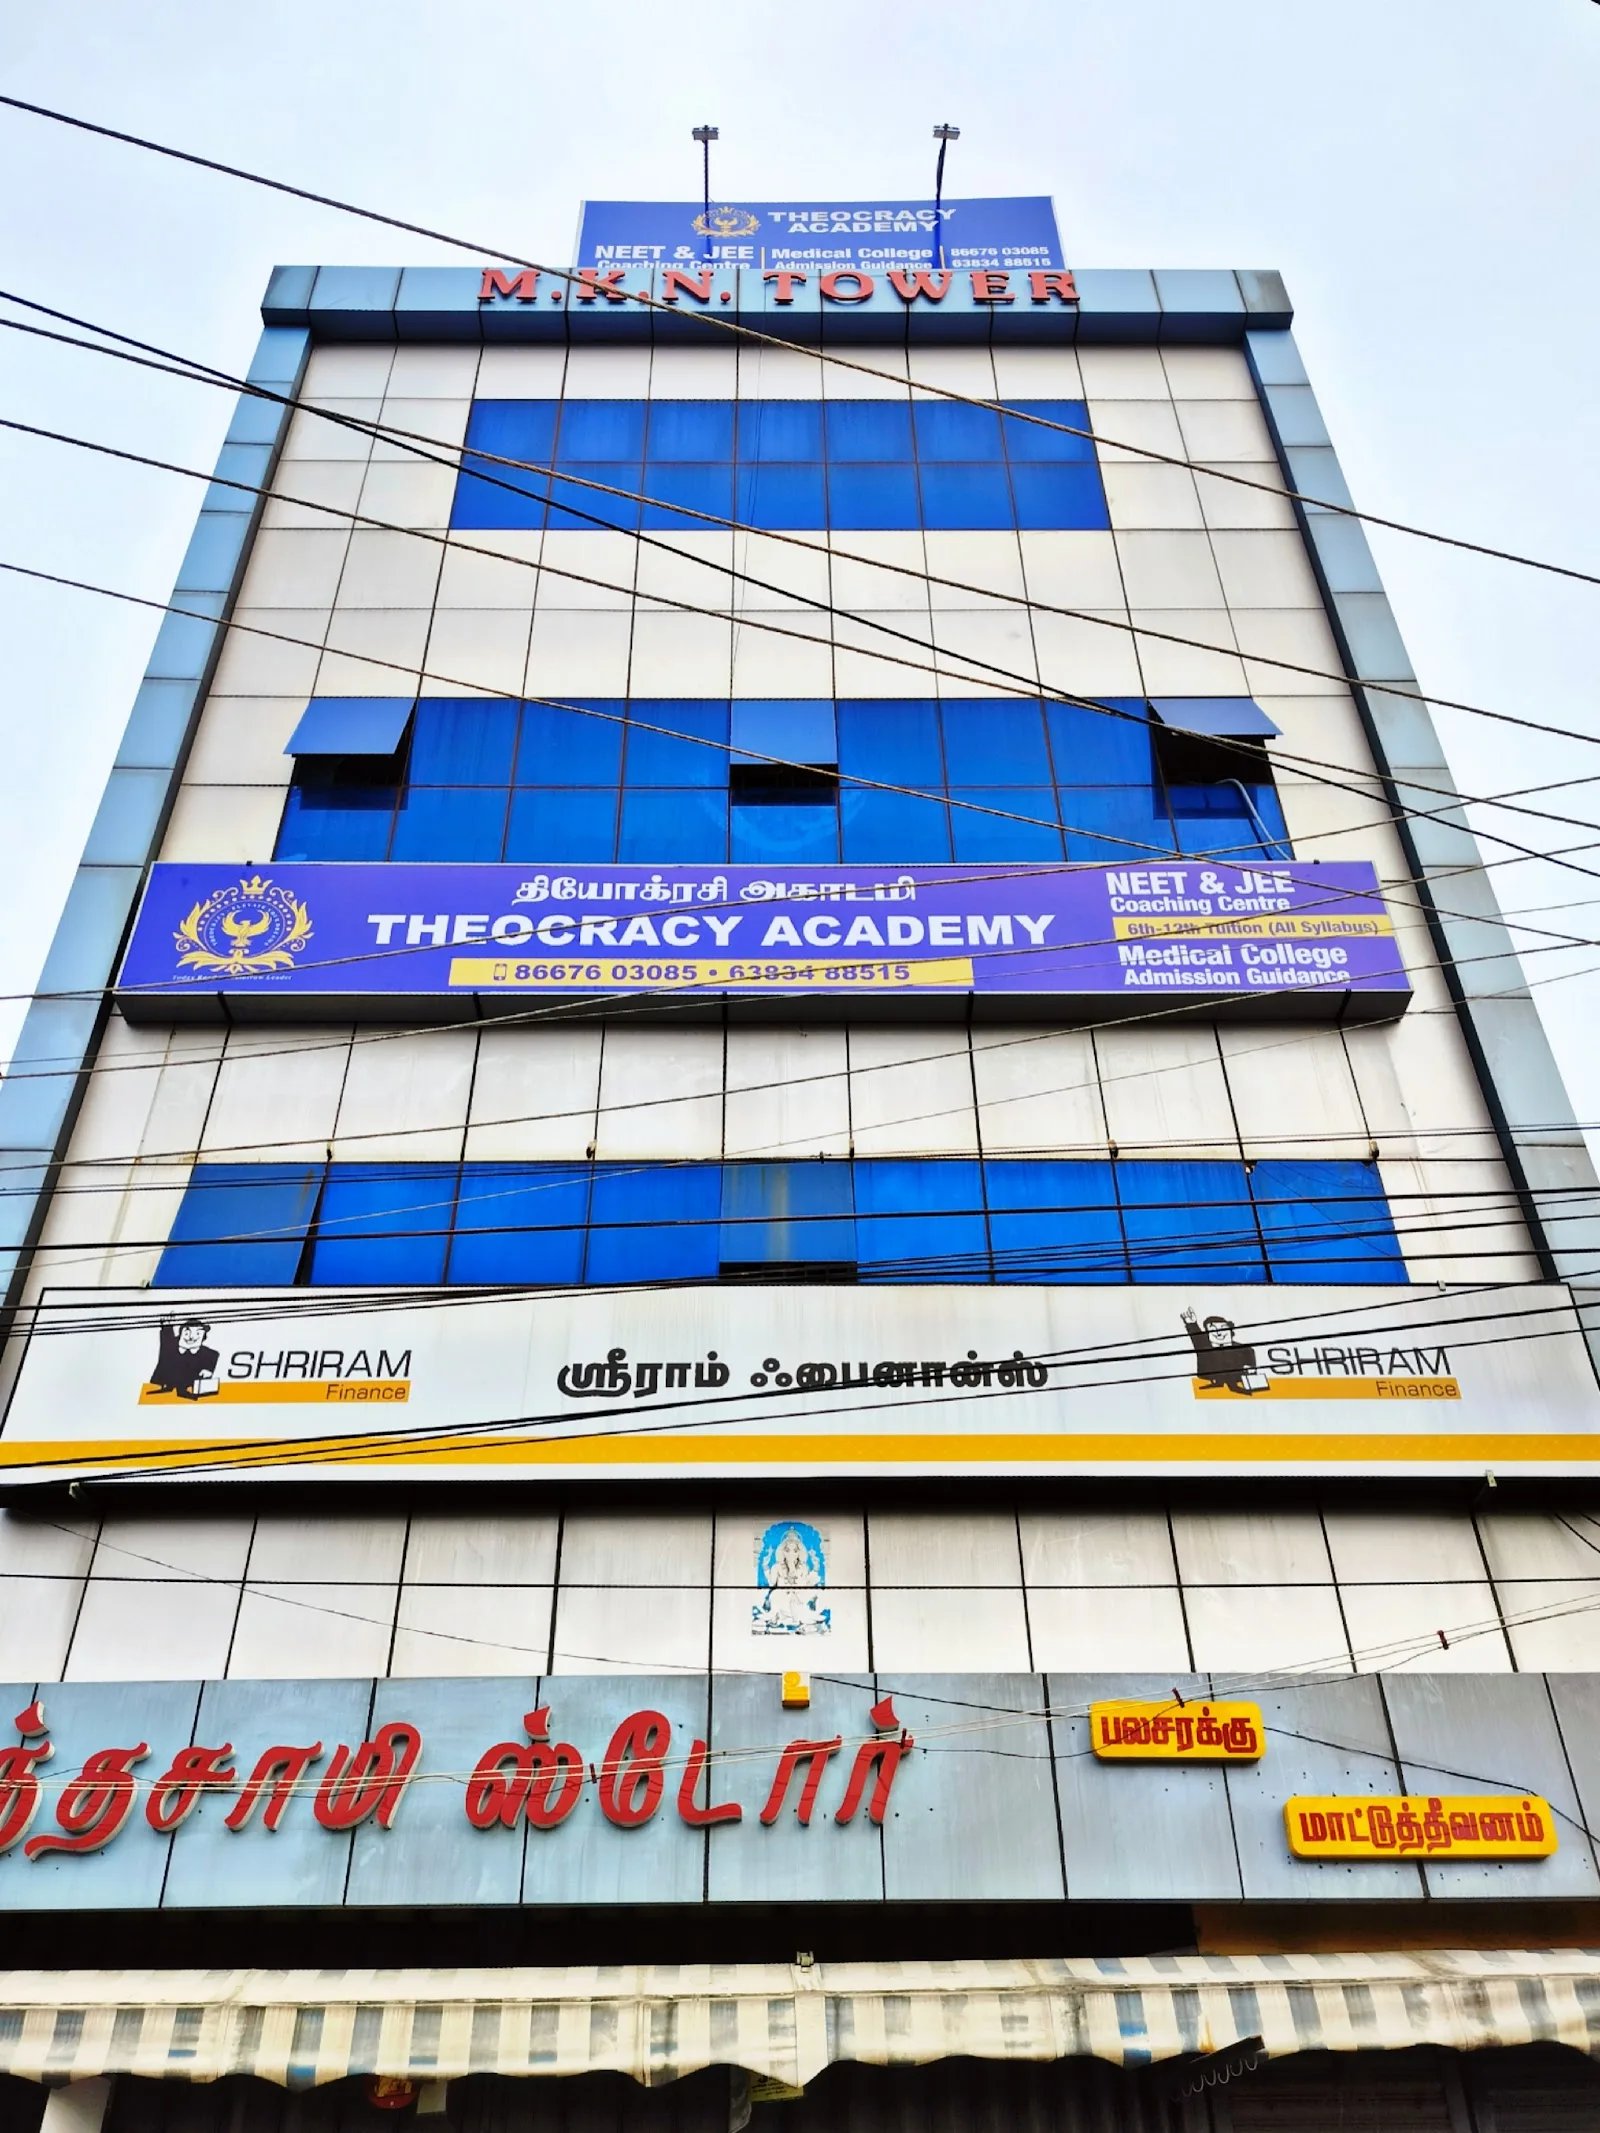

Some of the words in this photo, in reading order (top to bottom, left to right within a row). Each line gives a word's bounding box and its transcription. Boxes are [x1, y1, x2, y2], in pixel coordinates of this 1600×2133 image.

[768, 209, 956, 222] THEOCRACY
[787, 220, 939, 233] ACADEMY
[595, 245, 666, 259] NEET
[673, 245, 695, 259] &
[703, 245, 754, 259] JEE
[771, 248, 851, 259] Medical
[858, 248, 933, 261] College
[951, 247, 998, 257] 86676
[1002, 246, 1049, 256] 03085
[598, 260, 685, 270] Coaching
[689, 260, 750, 270] Centre
[775, 260, 857, 270] Admission
[862, 260, 932, 270] Guidance
[952, 258, 1000, 268] 63834
[1003, 257, 1051, 268] 88515
[477, 269, 732, 304] M.K.N.
[762, 270, 1082, 305] TOWER
[511, 874, 728, 906] தியோக்ரசி
[739, 875, 917, 902] அகாடமி
[1105, 871, 1187, 896] NEET
[1199, 871, 1225, 895] &
[1235, 871, 1296, 895] JEE
[1110, 896, 1212, 915] Coaching
[1218, 895, 1291, 912] Centre
[367, 913, 744, 947] THEOCRACY
[761, 913, 1056, 948] ACADEMY
[1269, 921, 1297, 936] (All
[1302, 920, 1379, 936] Syllabus)
[1117, 943, 1232, 967] Medical
[1240, 943, 1348, 968] College
[515, 963, 601, 980] 86676
[611, 963, 698, 980] 03085
[728, 964, 815, 980] 63834
[824, 964, 910, 980] 88515
[1124, 968, 1241, 986] Admission
[1246, 967, 1351, 985] Guidance
[226, 1349, 412, 1379] SHRIRAM
[1266, 1347, 1452, 1376] SHRIRAM
[557, 1347, 731, 1399] ஸ்ரீராம்
[750, 1350, 1049, 1388] ஃபைனான்ஸ்
[325, 1383, 406, 1401] Finance
[1375, 1380, 1457, 1397] Finance
[1101, 1705, 1258, 1754] பலசரக்கு
[465, 1695, 915, 1830] ஸ்டோர்
[1298, 1796, 1545, 1854] மாட்டுத்தீவனம்
